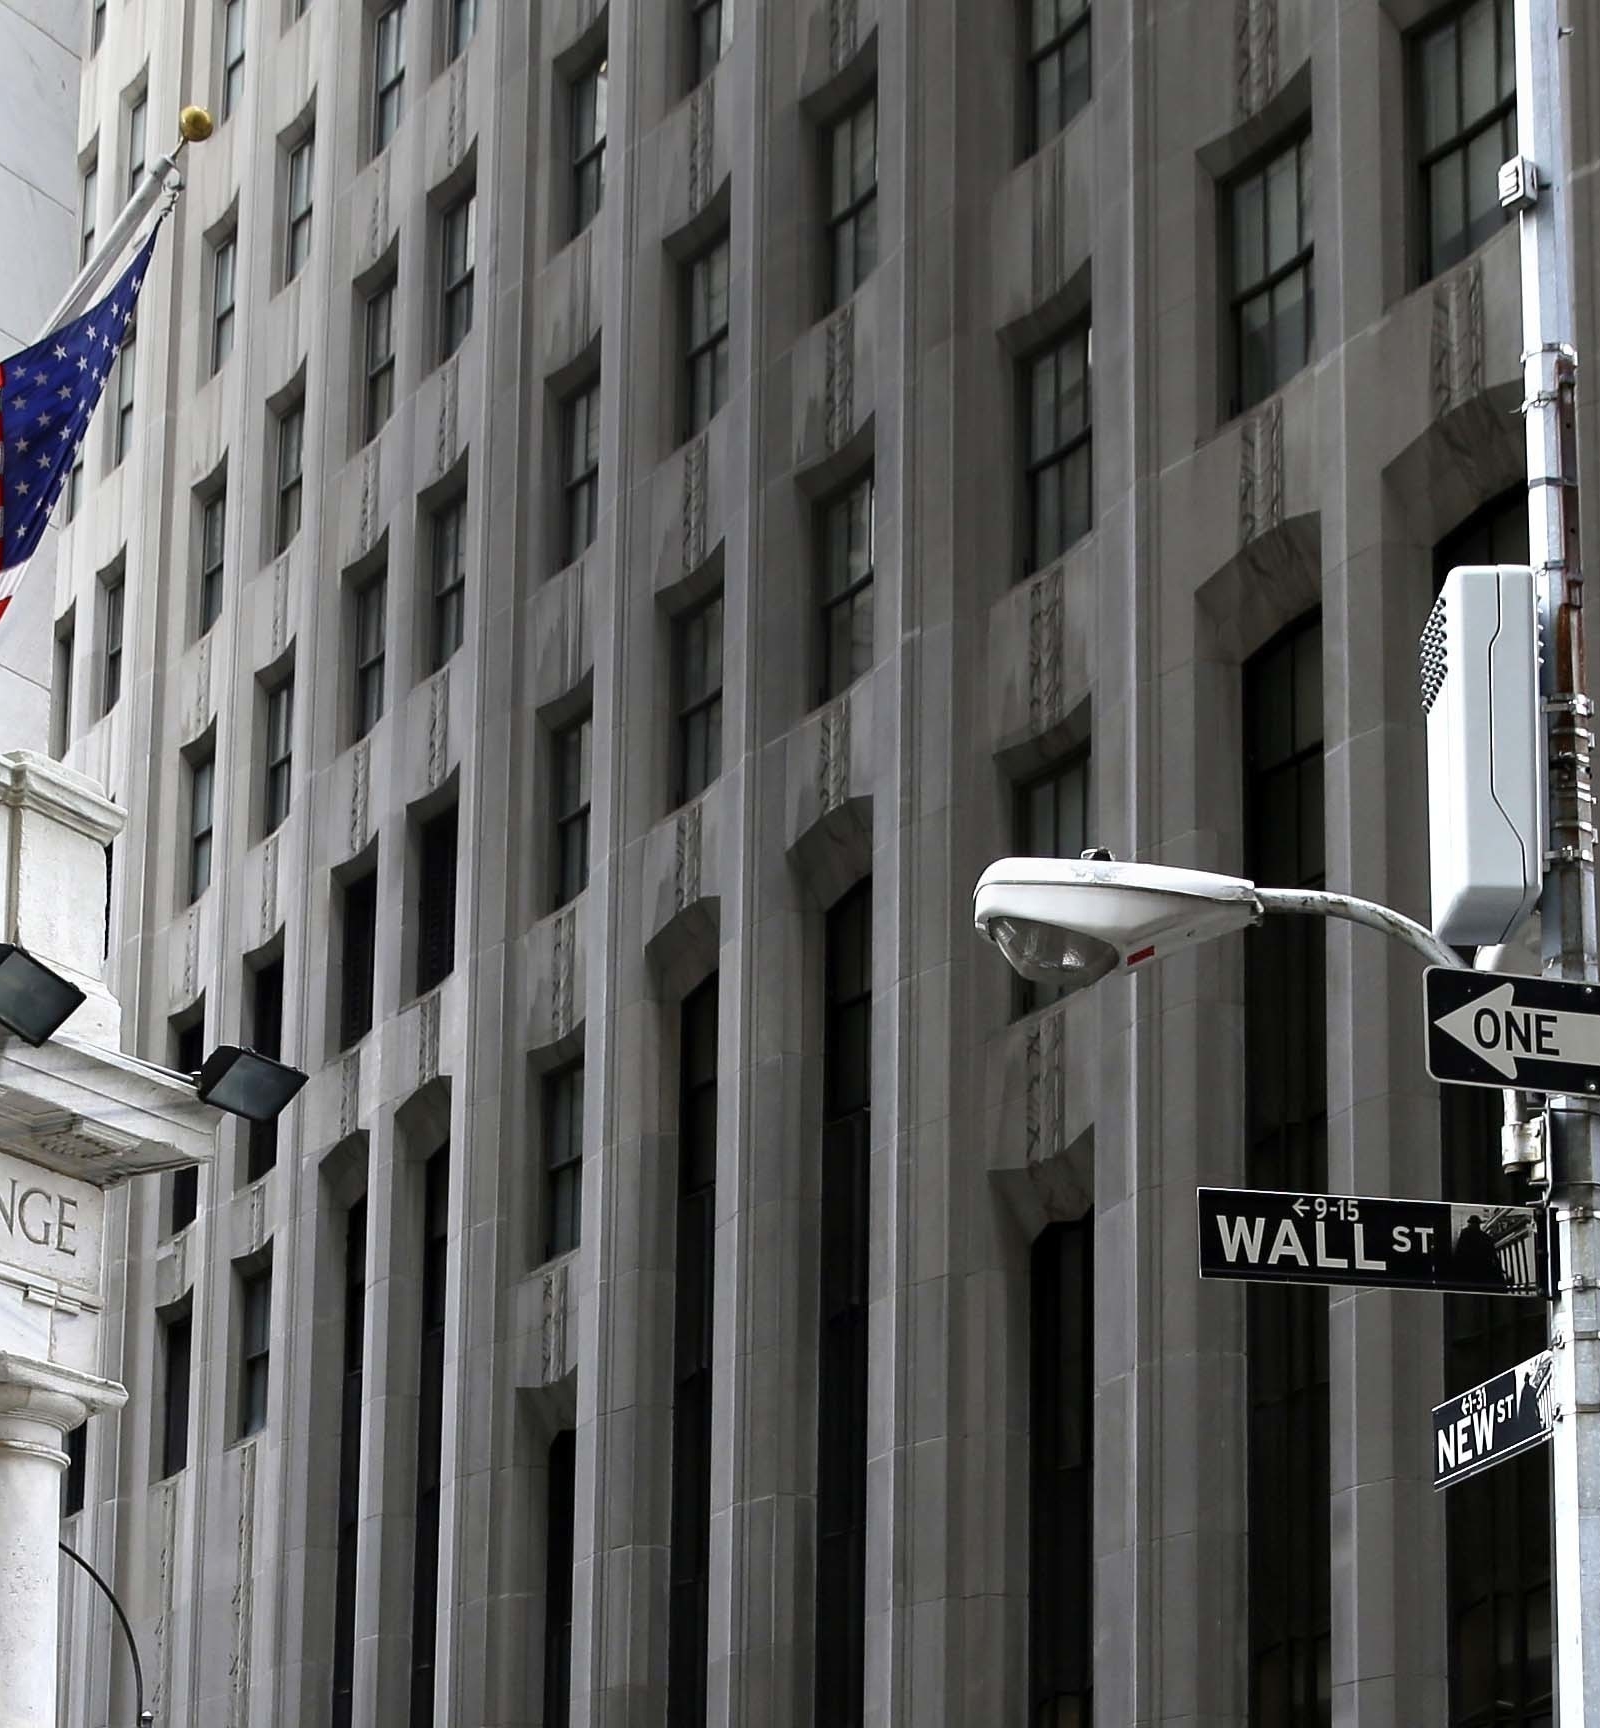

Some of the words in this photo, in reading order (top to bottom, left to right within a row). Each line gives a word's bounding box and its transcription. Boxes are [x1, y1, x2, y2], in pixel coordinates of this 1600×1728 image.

[1473, 1007, 1560, 1056] ONE
[1314, 1198, 1359, 1221] 9-15
[1216, 1215, 1386, 1271] WALL
[1392, 1226, 1434, 1254] ST
[1468, 1387, 1487, 1413] 1-31
[1437, 1404, 1495, 1474] NEW
[1497, 1394, 1514, 1424] ST
